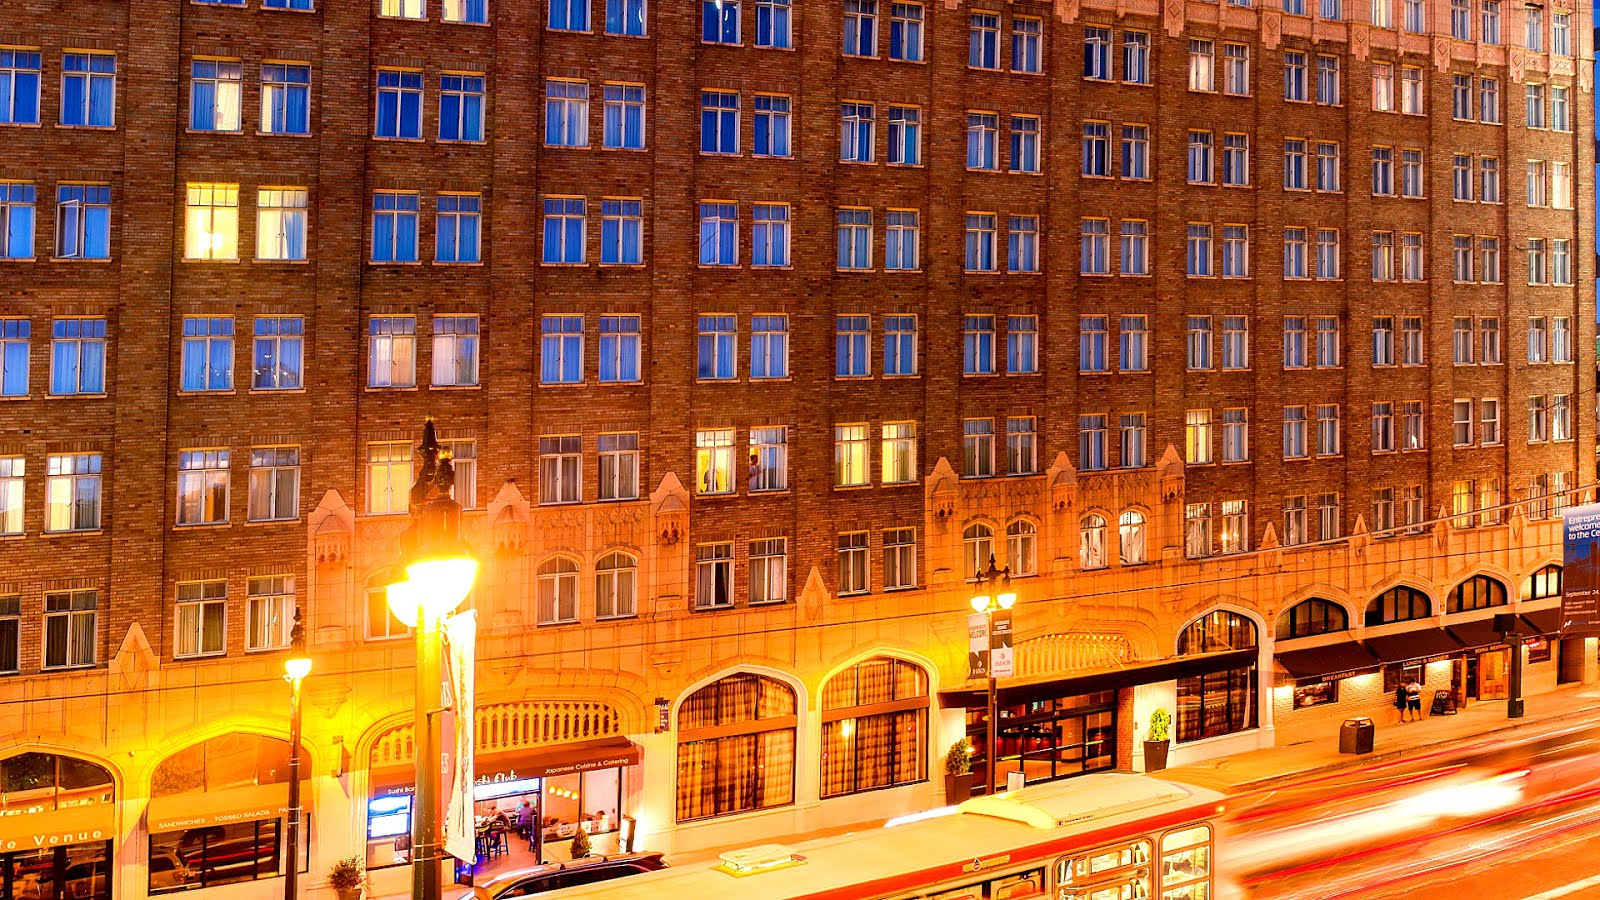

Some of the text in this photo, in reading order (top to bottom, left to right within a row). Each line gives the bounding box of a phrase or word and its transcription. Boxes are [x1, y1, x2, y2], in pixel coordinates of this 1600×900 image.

[1568, 522, 1600, 532] welcome
[1568, 532, 1576, 540] to
[1577, 530, 1590, 539] the
[1402, 659, 1421, 668] LUNCH
[1428, 654, 1450, 663] DINNER
[1321, 671, 1356, 682] BREAKFAST
[545, 765, 575, 775] Japanese
[575, 761, 597, 770] Cuisine
[603, 757, 629, 767] Catering
[494, 769, 518, 783] Club
[387, 787, 404, 795] Sushi
[158, 817, 206, 829] SANDWICHES
[214, 813, 242, 822] TOSSED
[243, 809, 271, 818] SALADS
[33, 830, 102, 846] Venue
